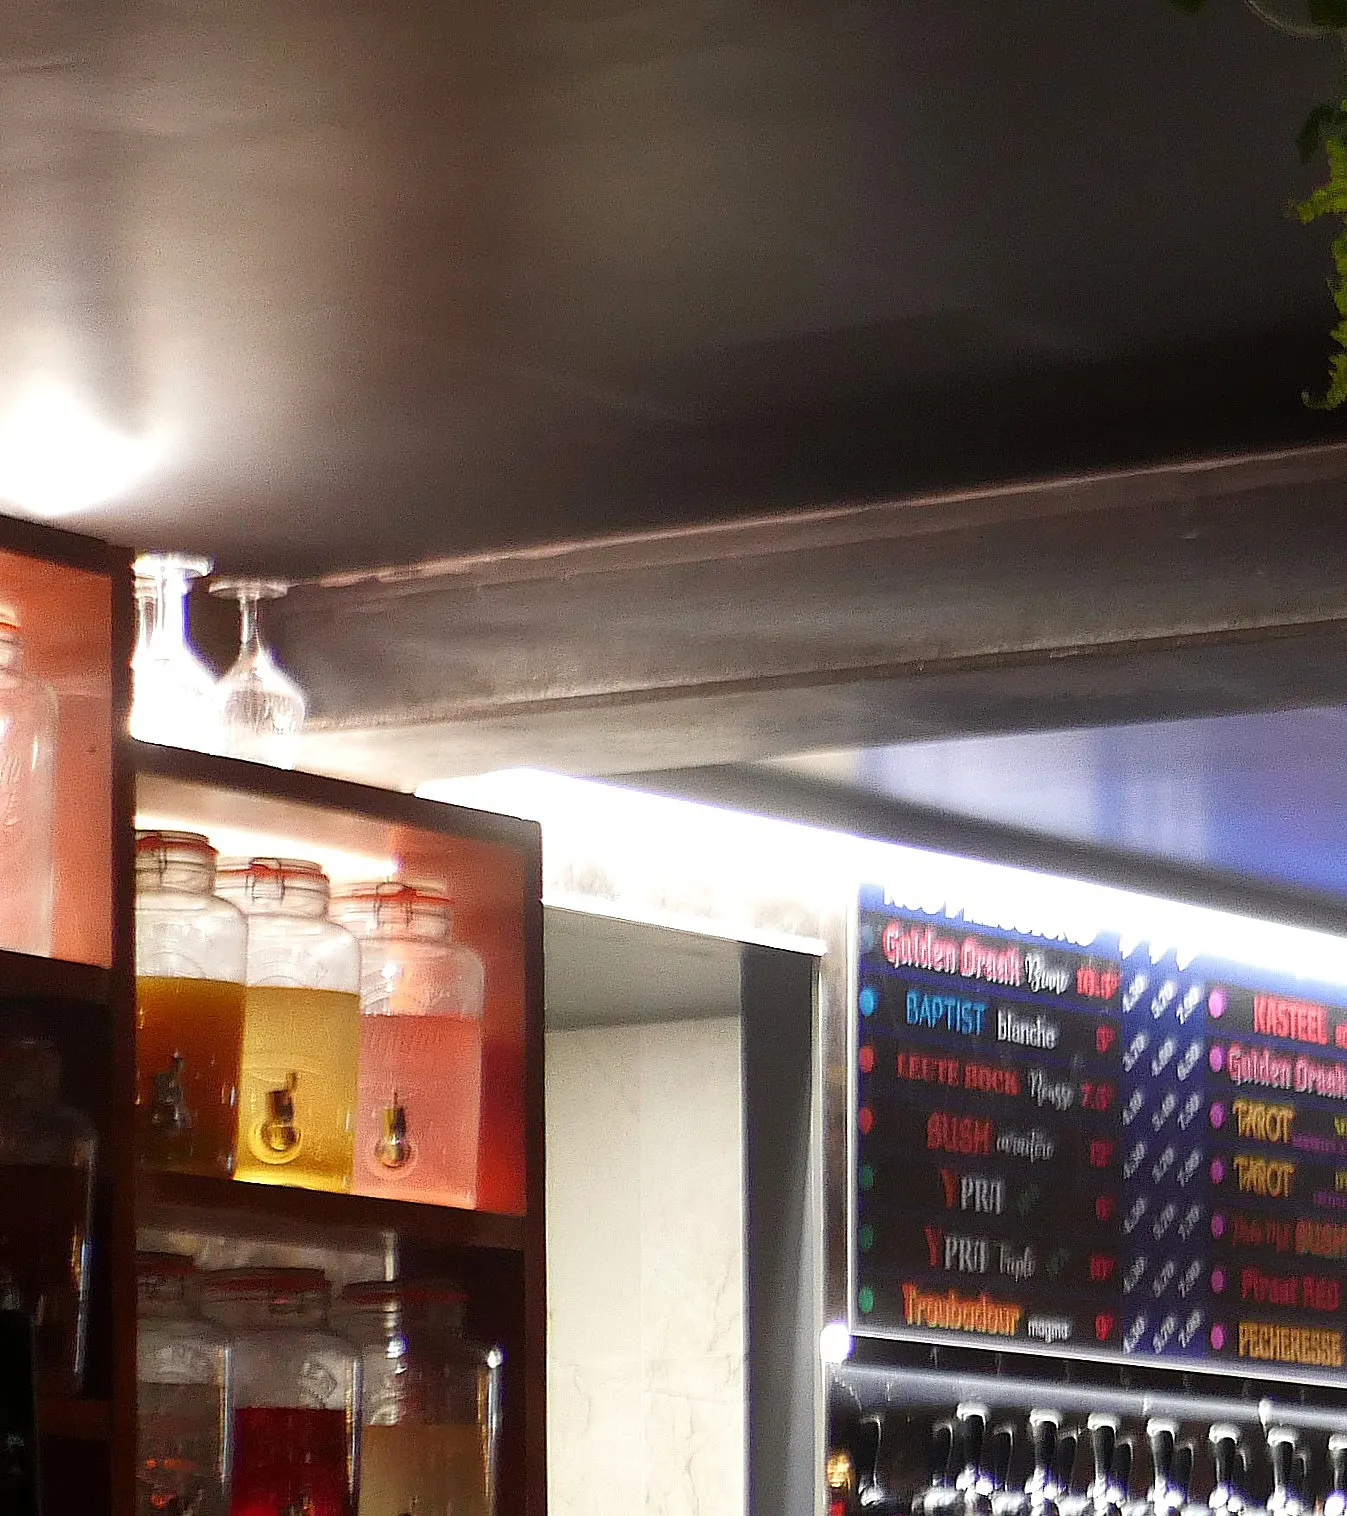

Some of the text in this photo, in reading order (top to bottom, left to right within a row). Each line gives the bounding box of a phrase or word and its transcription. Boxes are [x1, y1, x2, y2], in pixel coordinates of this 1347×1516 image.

[906, 990, 989, 1035] BAPTIST
[997, 1008, 1059, 1050] blanche
[1254, 994, 1329, 1046] KASTEEL
[902, 1280, 1023, 1336] Troubadour
[1238, 1320, 1345, 1368] PECHERESSE
